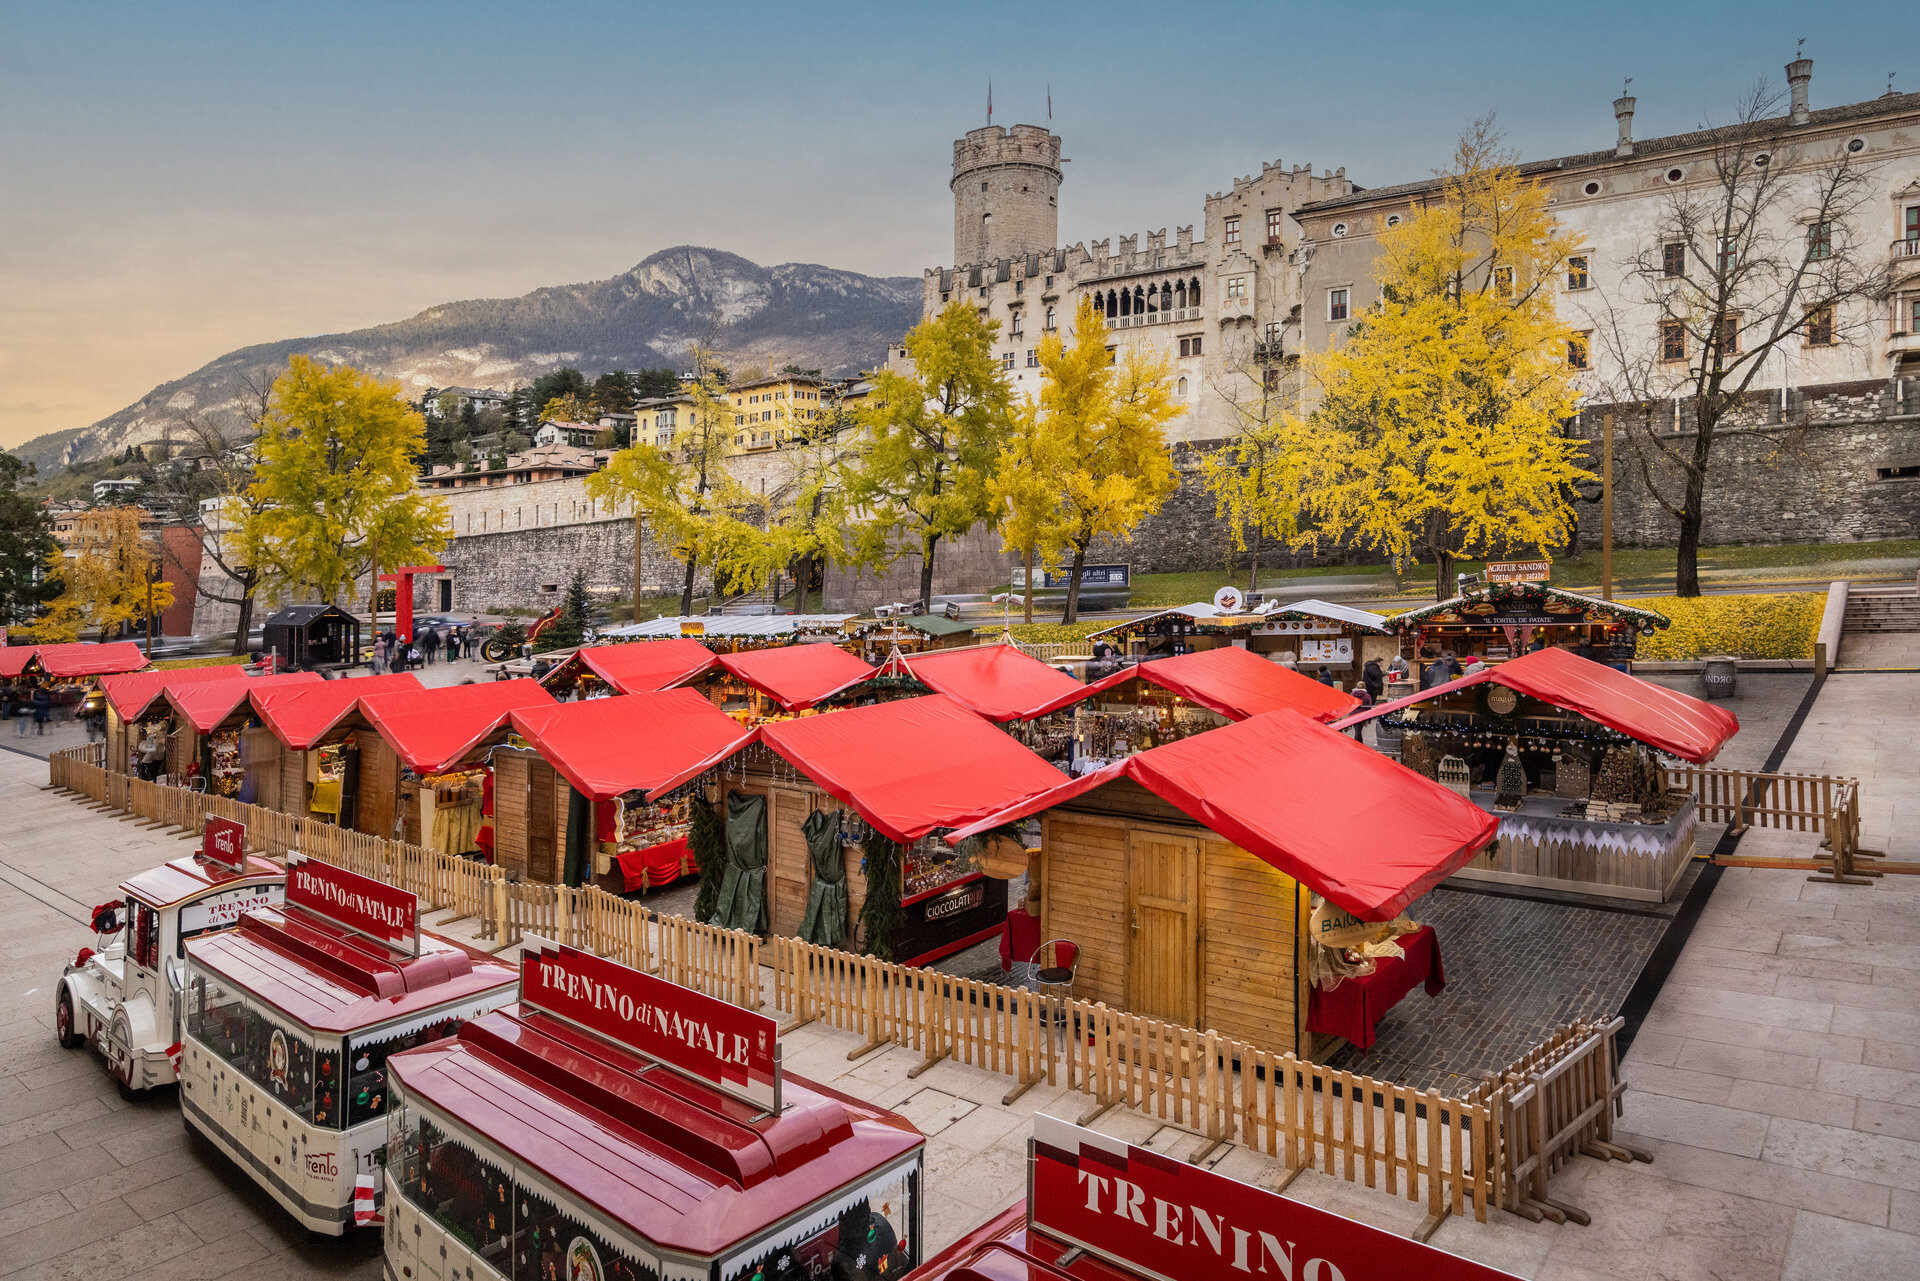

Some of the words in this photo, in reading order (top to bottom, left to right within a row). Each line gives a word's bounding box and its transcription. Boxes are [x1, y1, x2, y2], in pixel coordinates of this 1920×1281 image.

[1092, 569, 1106, 577] altri
[1488, 563, 1516, 573] AGRITUR
[1518, 562, 1548, 571] SANDRO
[215, 829, 234, 854] Trento
[209, 897, 269, 915] TRENINO
[296, 871, 346, 907] TRENINO
[346, 893, 355, 908] di
[356, 894, 404, 928] NATALE
[209, 916, 219, 924] di
[540, 963, 634, 1021] TRENINO
[636, 1003, 651, 1026] di
[654, 1007, 749, 1066] NATALE
[305, 1152, 338, 1177] Trento
